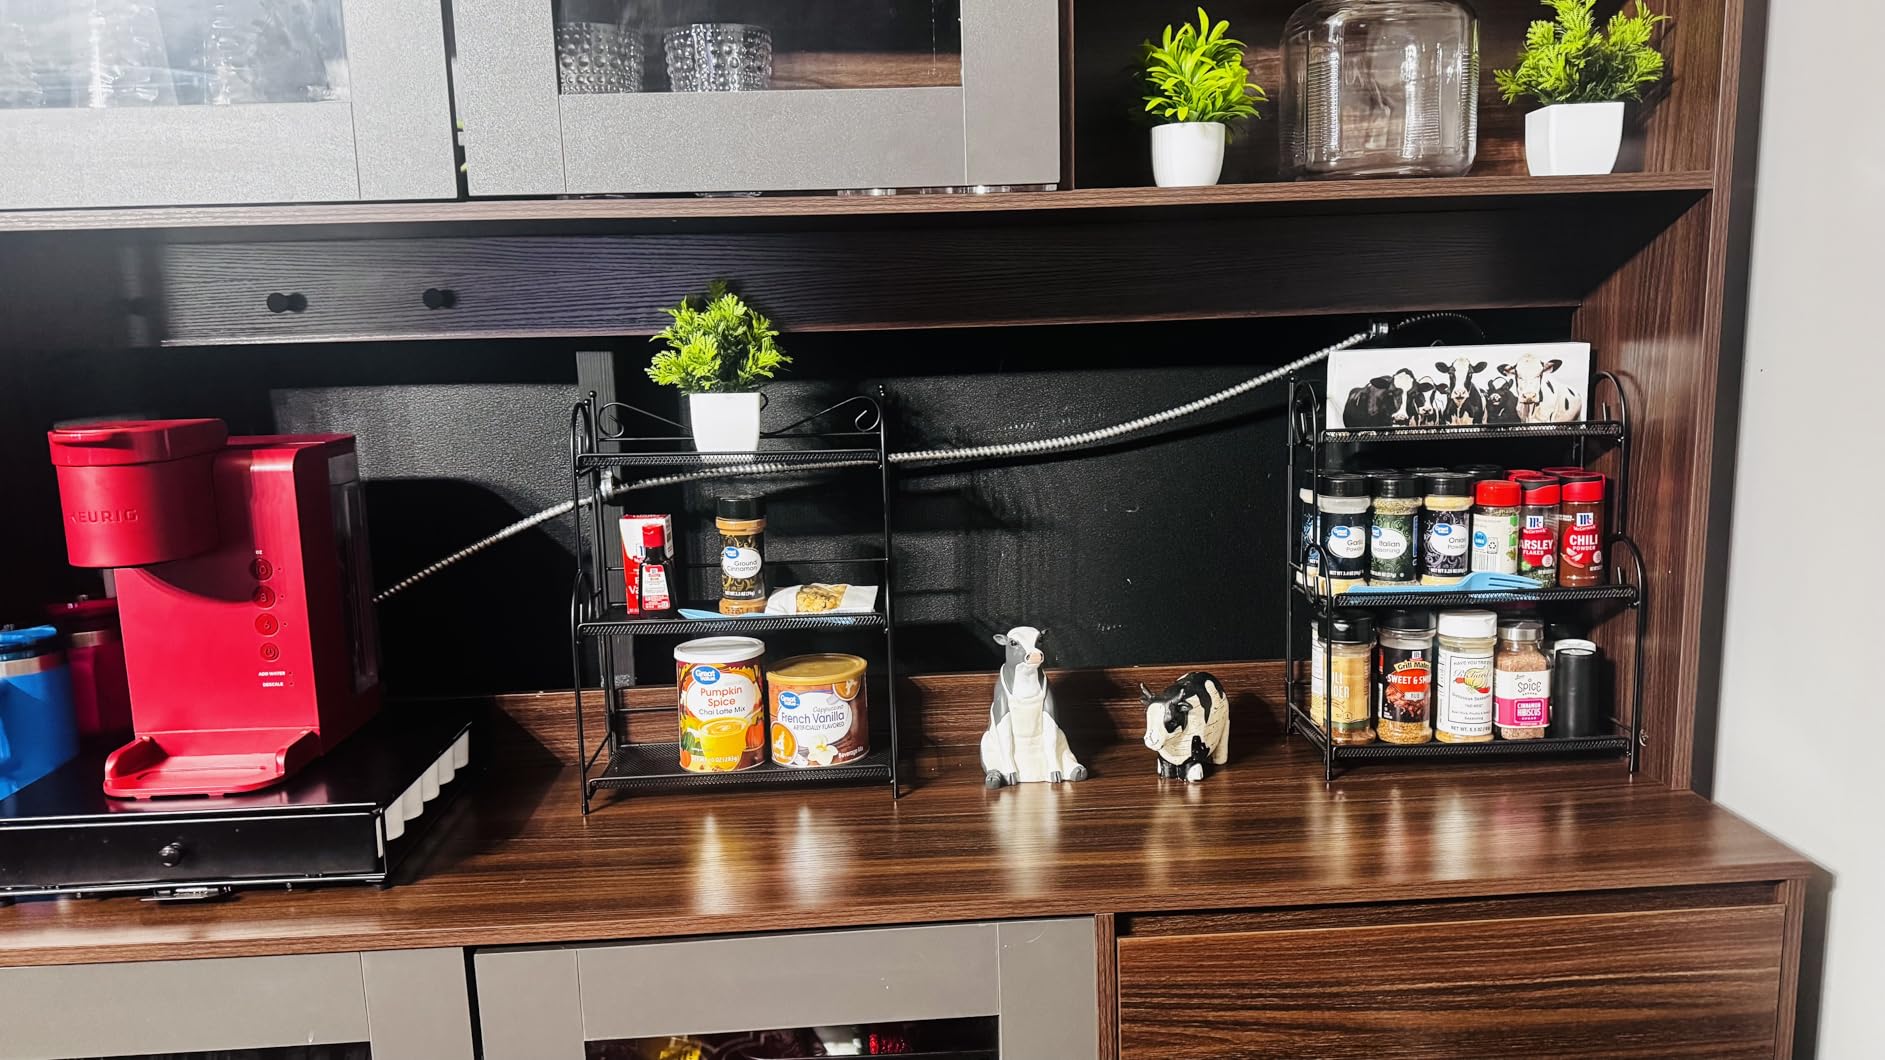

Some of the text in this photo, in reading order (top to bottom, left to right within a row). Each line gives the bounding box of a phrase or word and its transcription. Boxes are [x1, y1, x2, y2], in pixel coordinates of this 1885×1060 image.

[1519, 539, 1553, 550] ARSLEY
[1569, 534, 1598, 545] CHILI
[1397, 662, 1412, 670] Grill
[1387, 673, 1411, 684] SWEET
[700, 686, 742, 698] Pumpkin
[708, 697, 735, 708] Spice
[716, 707, 732, 715] Latte
[781, 711, 844, 723] French Vanilla
[822, 722, 844, 730] FLAVORED
